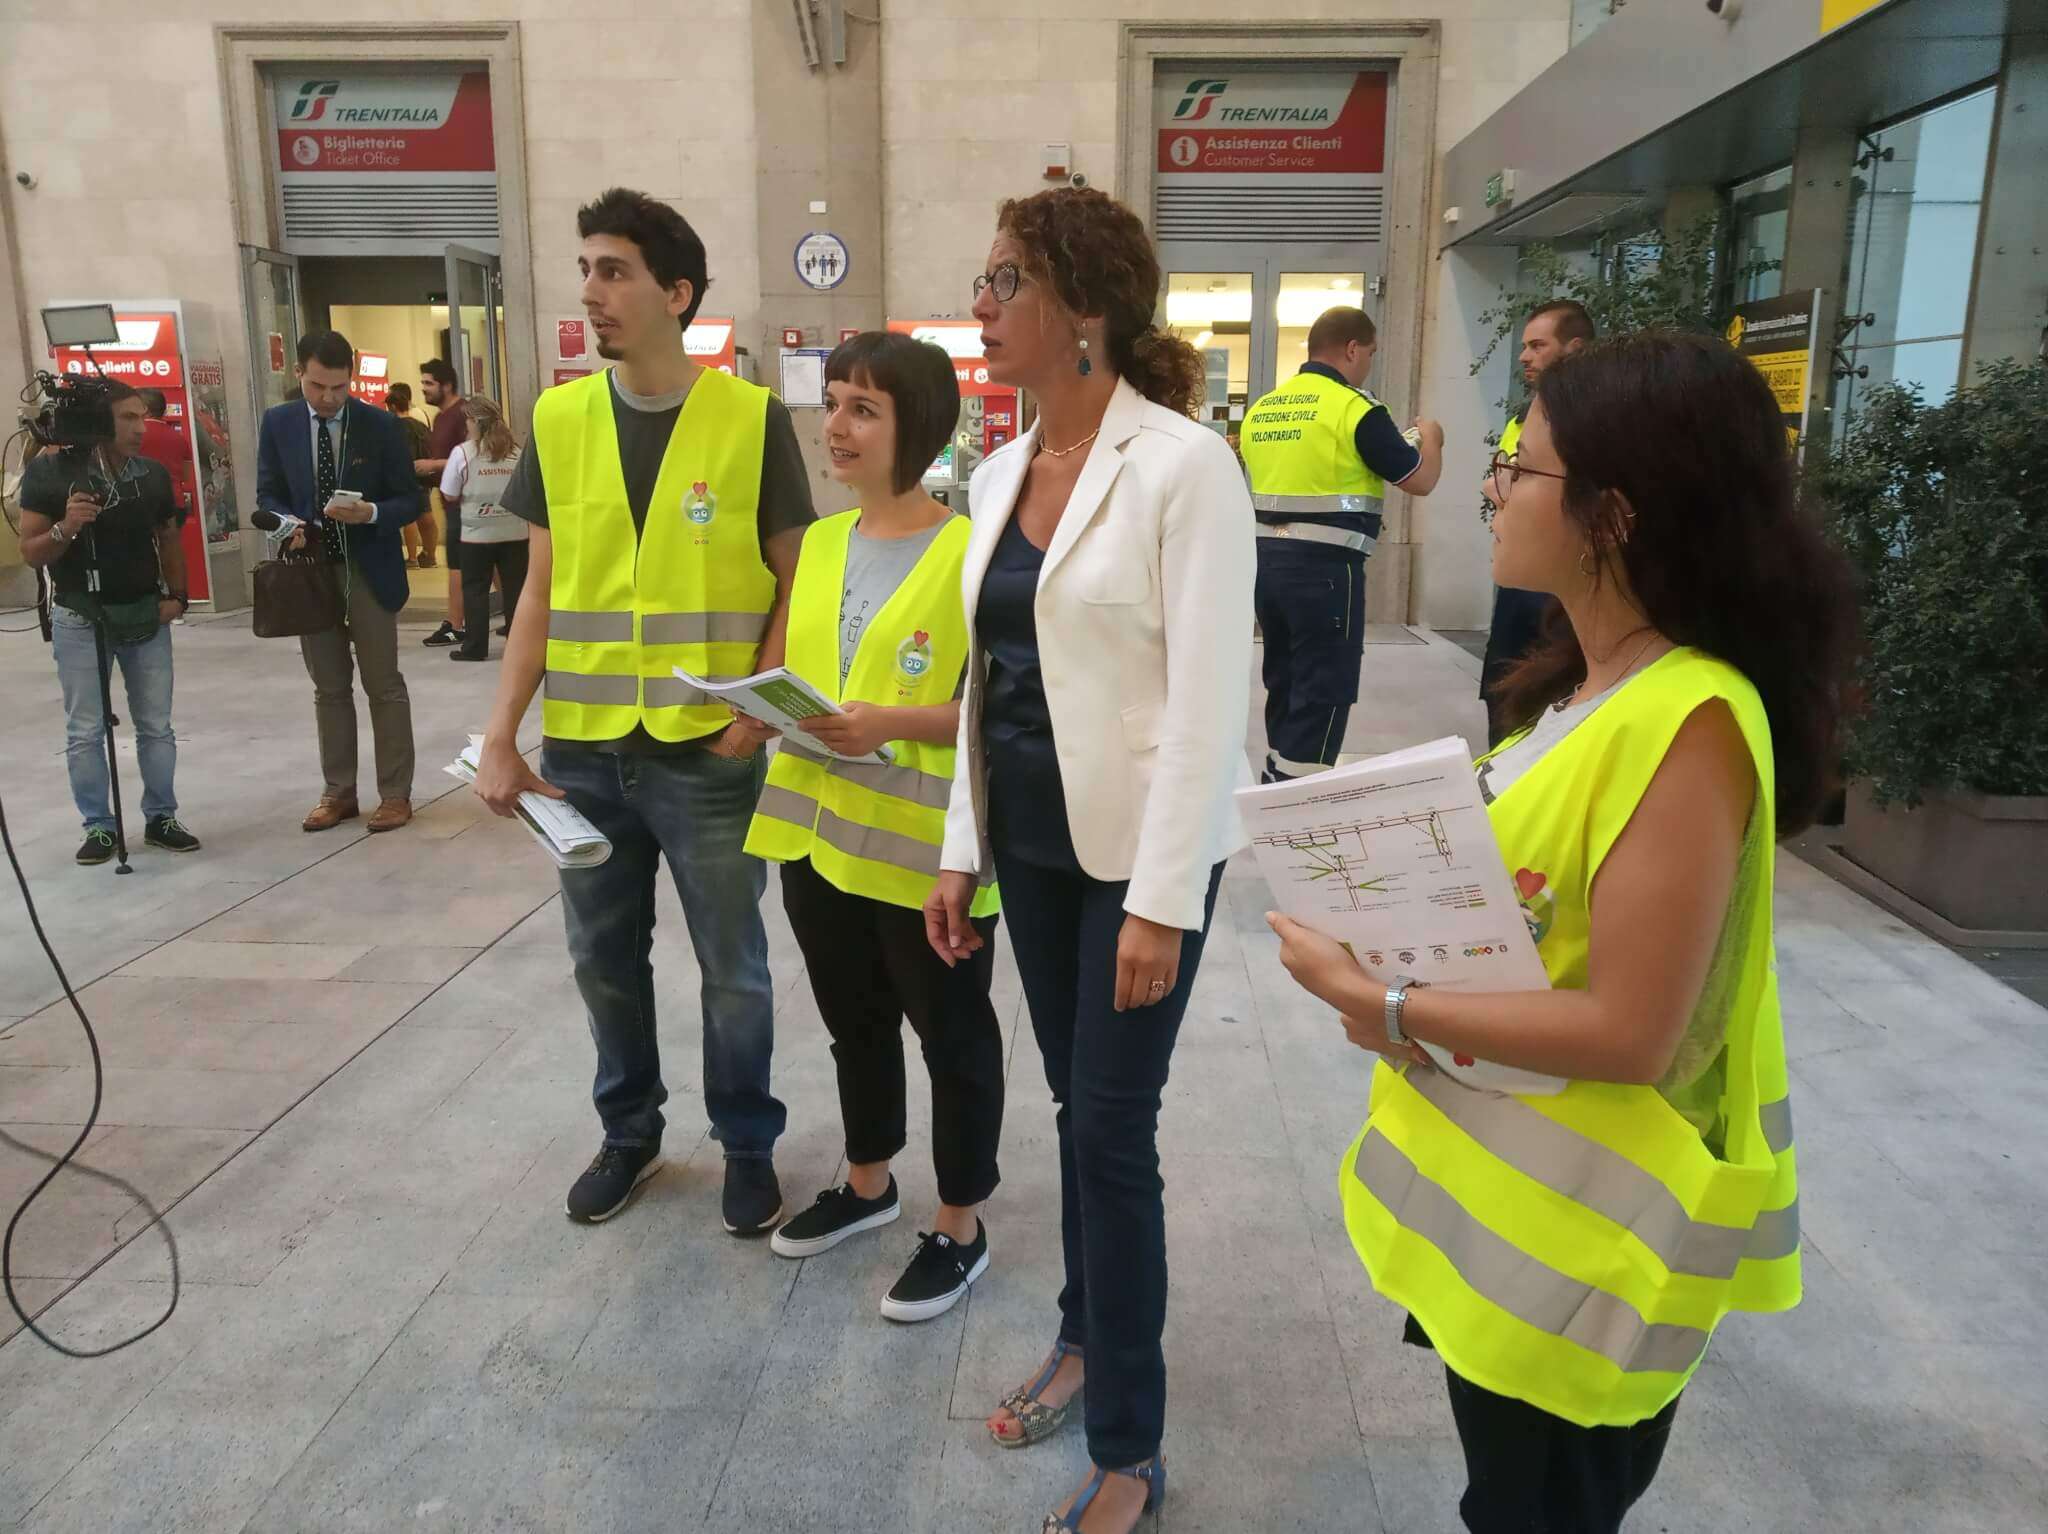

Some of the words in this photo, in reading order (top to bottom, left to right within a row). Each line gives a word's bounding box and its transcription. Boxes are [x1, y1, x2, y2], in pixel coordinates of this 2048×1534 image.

[335, 108, 440, 122] TRENITALIA
[1220, 107, 1330, 122] TRENITALIA
[324, 135, 406, 152] Biglietteria
[1204, 136, 1288, 150] Assistenza
[1292, 135, 1343, 150] Clienti
[326, 151, 360, 165] Ticket
[362, 151, 401, 166] Office
[1203, 152, 1265, 167] Customer
[1268, 152, 1316, 168] Service
[191, 373, 222, 386] GRATIS
[1288, 394, 1320, 405] LIGURIA
[1292, 410, 1318, 421] CIVILE
[1251, 429, 1302, 442] VOLONTARIATO
